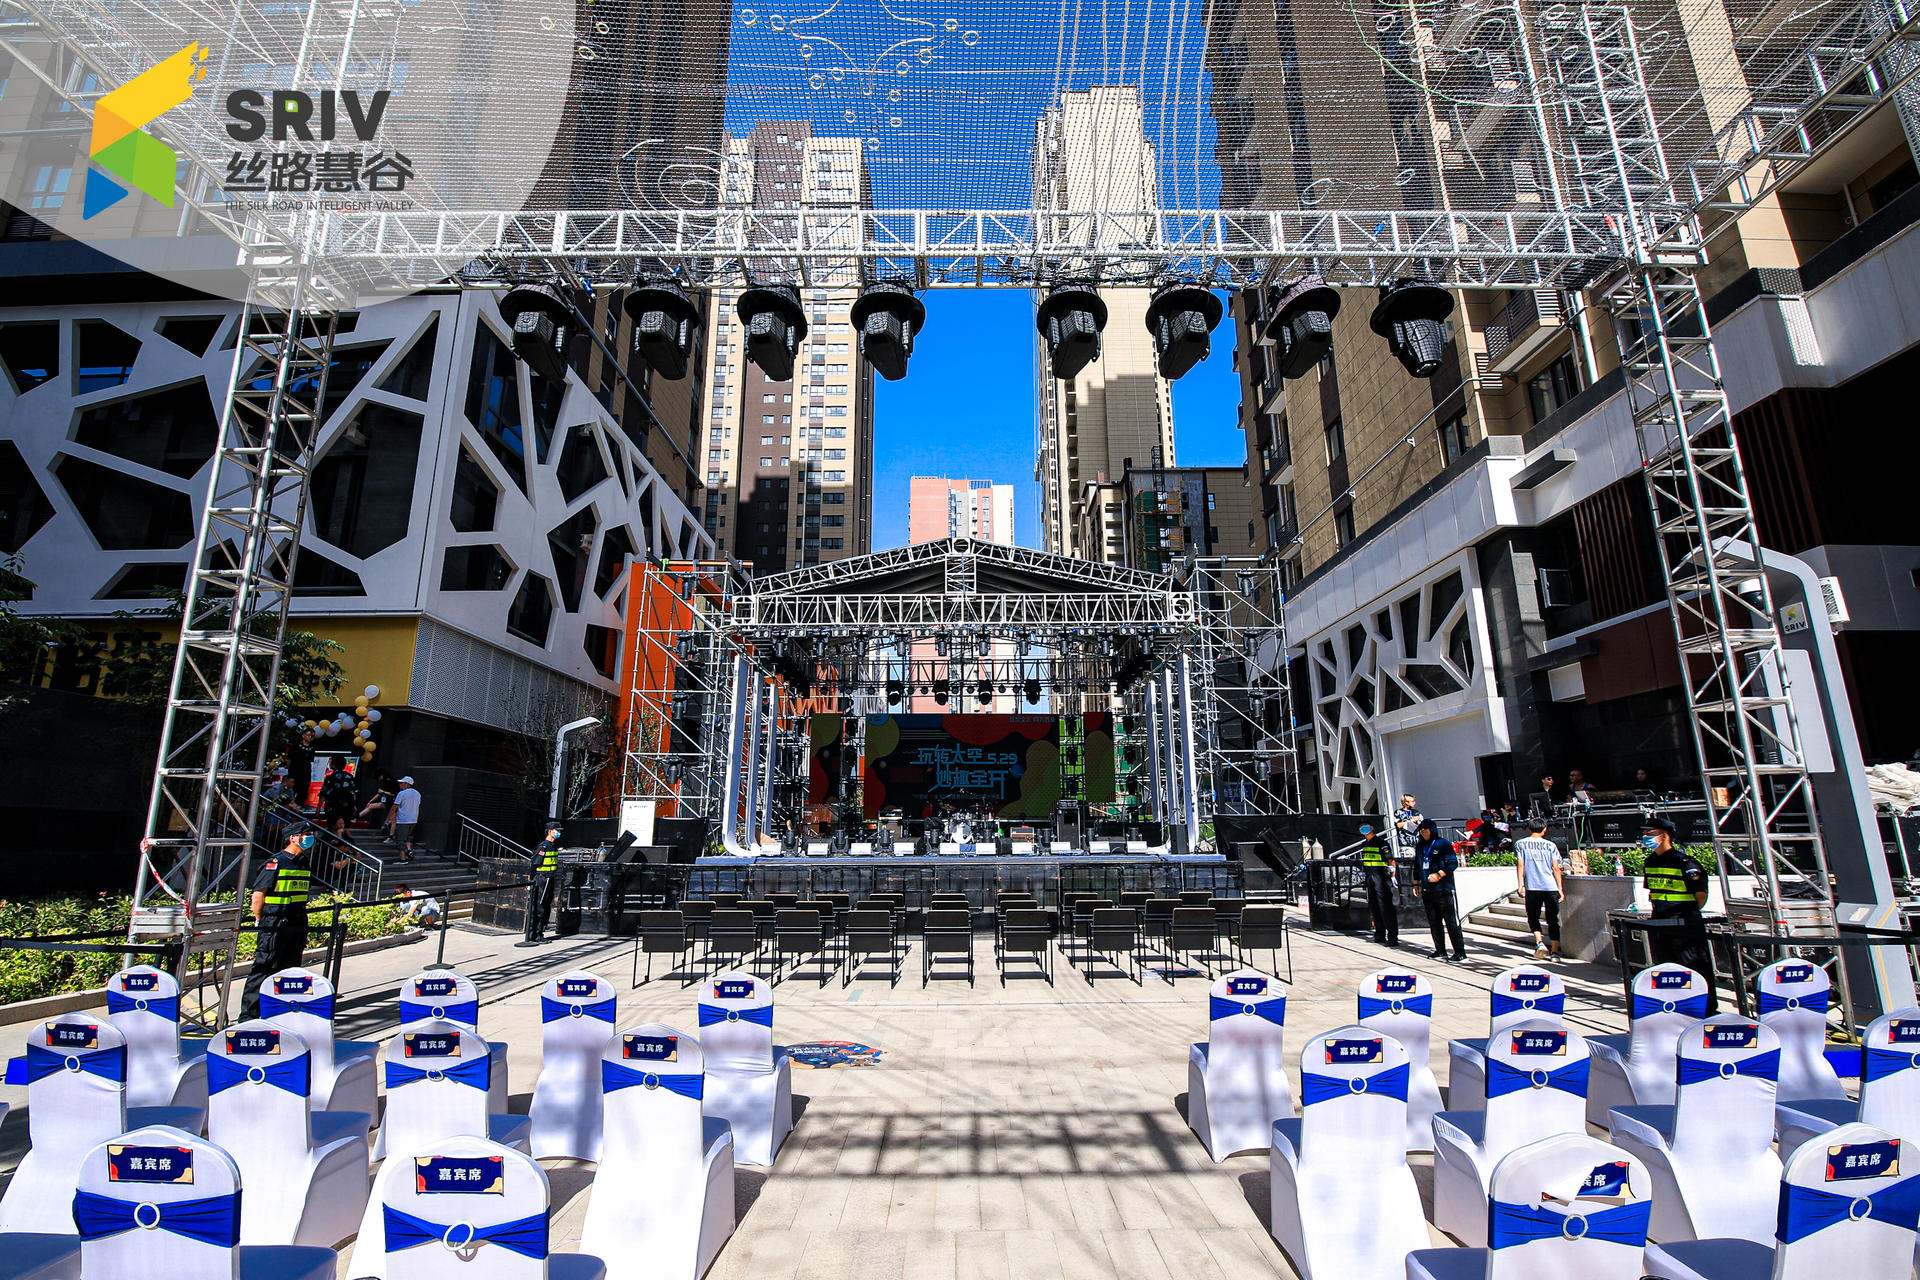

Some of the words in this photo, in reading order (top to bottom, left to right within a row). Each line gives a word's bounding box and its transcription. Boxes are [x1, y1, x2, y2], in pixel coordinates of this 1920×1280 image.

[1785, 621, 1805, 632] SRIV
[987, 753, 1018, 765] 5.29
[1785, 970, 1805, 978] 嘉宾席
[130, 978, 150, 986] 嘉宾席
[1386, 980, 1407, 988] 嘉宾席
[1520, 979, 1540, 987] 嘉宾席
[1661, 976, 1682, 984] 嘉宾席
[425, 983, 447, 991] 嘉宾席
[567, 984, 587, 992] 嘉宾席
[724, 985, 745, 993] 嘉宾席
[1237, 982, 1258, 990] 嘉宾席
[59, 1030, 85, 1041] 嘉宾席
[1717, 1032, 1744, 1041] 嘉宾席
[239, 1038, 267, 1047] 嘉宾席
[419, 1040, 447, 1049] 嘉宾席
[1525, 1038, 1553, 1048] 嘉宾席
[637, 1043, 664, 1053] 嘉宾席
[1339, 1046, 1369, 1056] 嘉宾席
[130, 1157, 172, 1171] 嘉宾席
[1845, 1151, 1882, 1169] 嘉宾席
[438, 1167, 482, 1181] 嘉宾席
